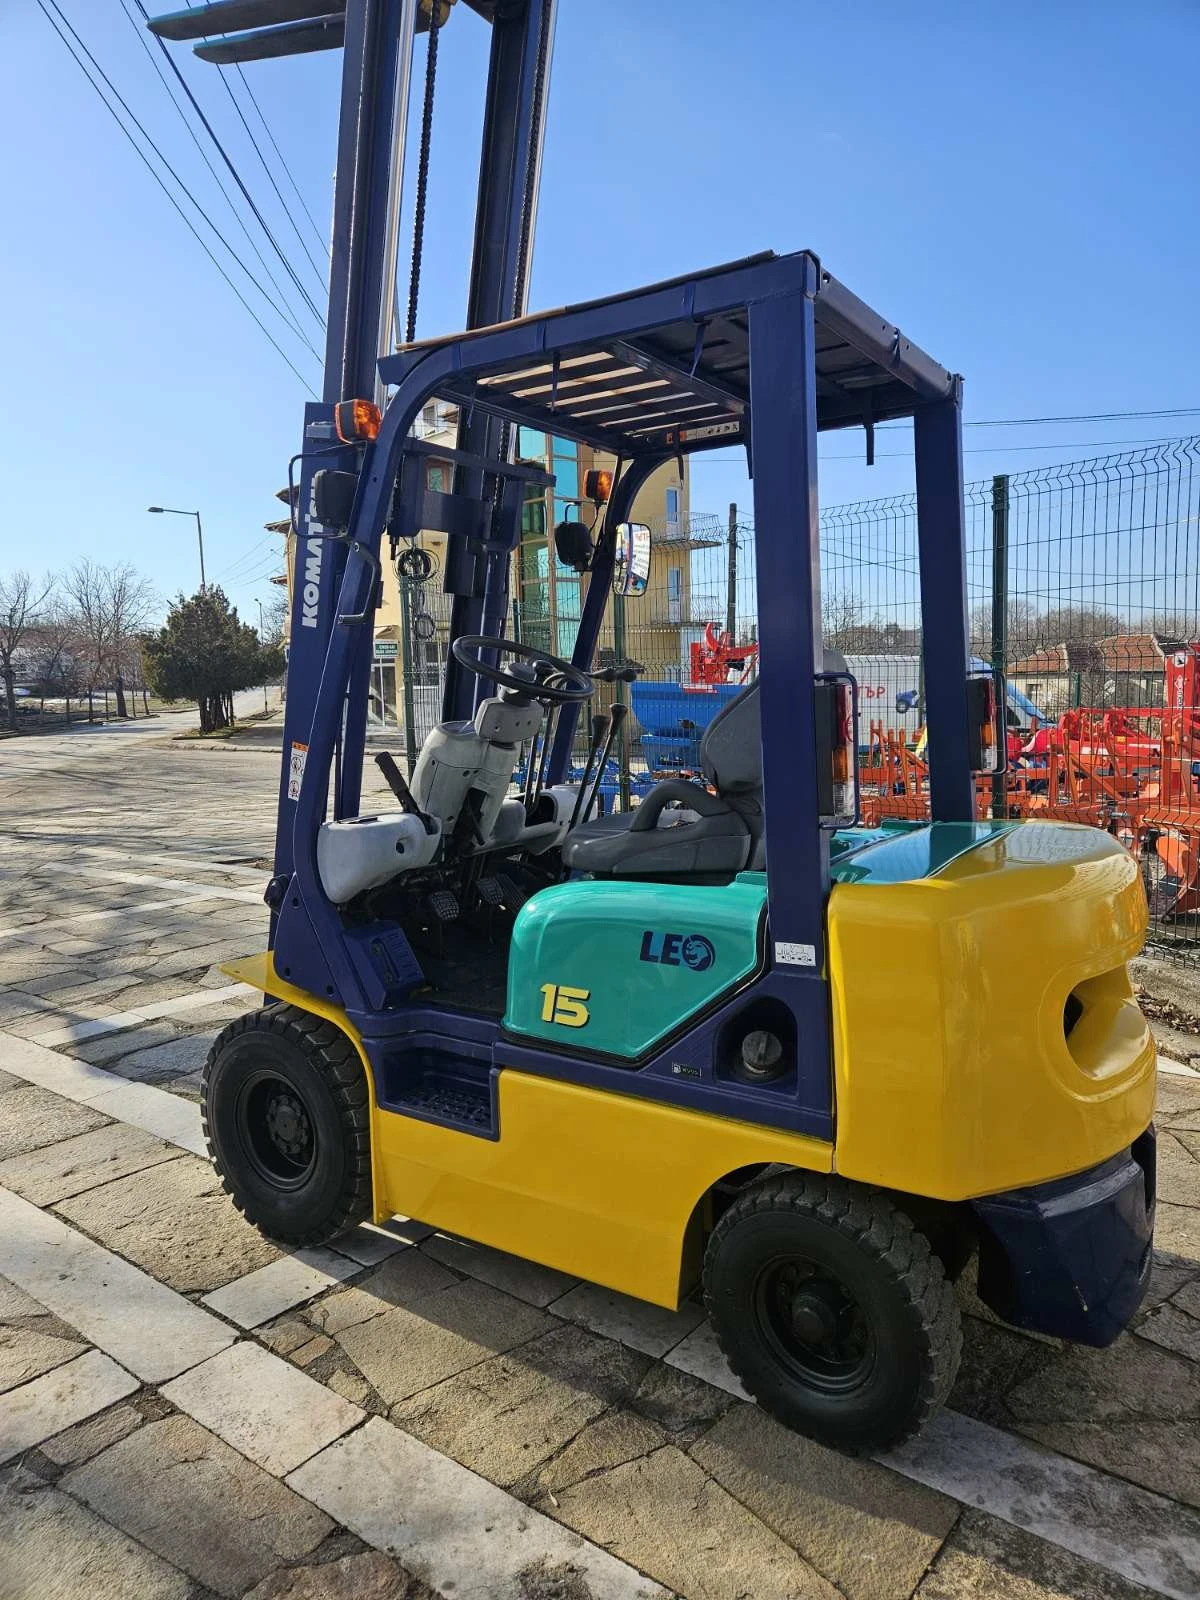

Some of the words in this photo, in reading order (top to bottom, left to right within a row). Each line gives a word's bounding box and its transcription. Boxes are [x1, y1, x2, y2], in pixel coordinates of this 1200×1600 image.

[302, 478, 324, 628] KOMAT
[640, 931, 715, 971] LEO
[540, 983, 591, 1028] 15
